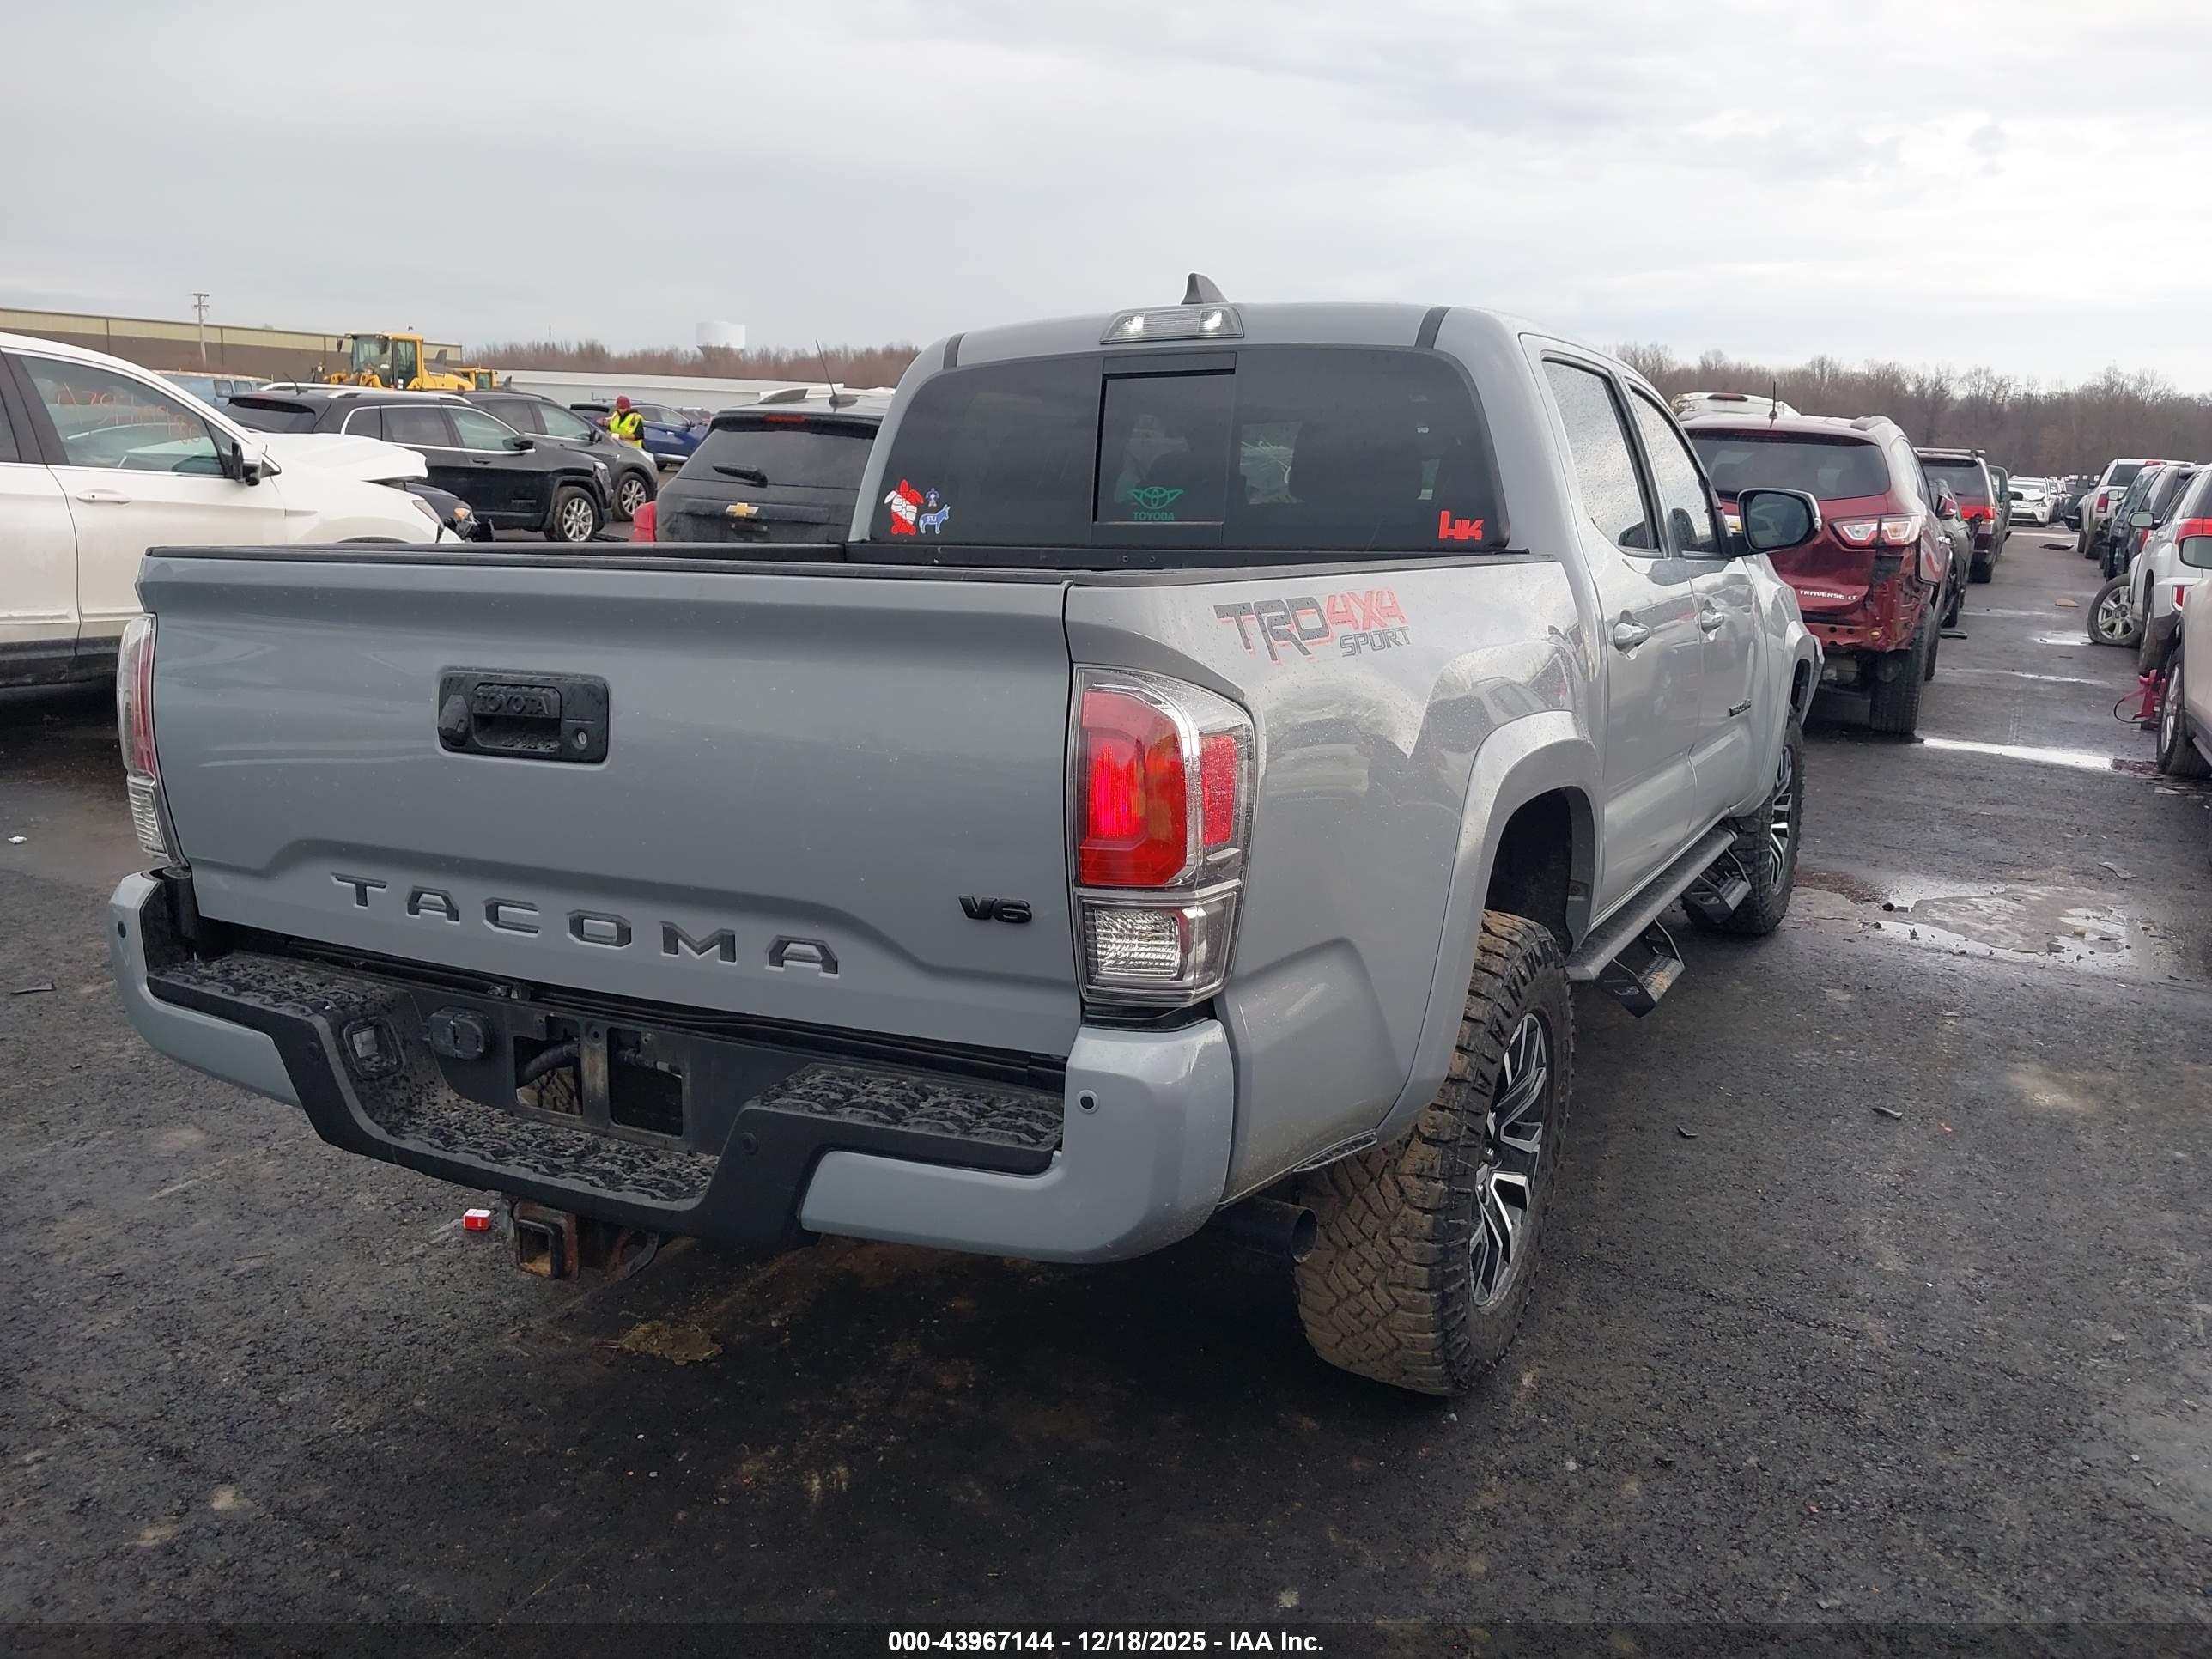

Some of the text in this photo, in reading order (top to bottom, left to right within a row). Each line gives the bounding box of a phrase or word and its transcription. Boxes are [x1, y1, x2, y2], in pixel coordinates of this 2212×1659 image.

[1800, 589, 1846, 600] TRAVERSE
[1213, 596, 1334, 665] TRD
[1339, 626, 1413, 659] SPORT
[331, 872, 841, 979] TACOMA
[957, 894, 1033, 924] V6
